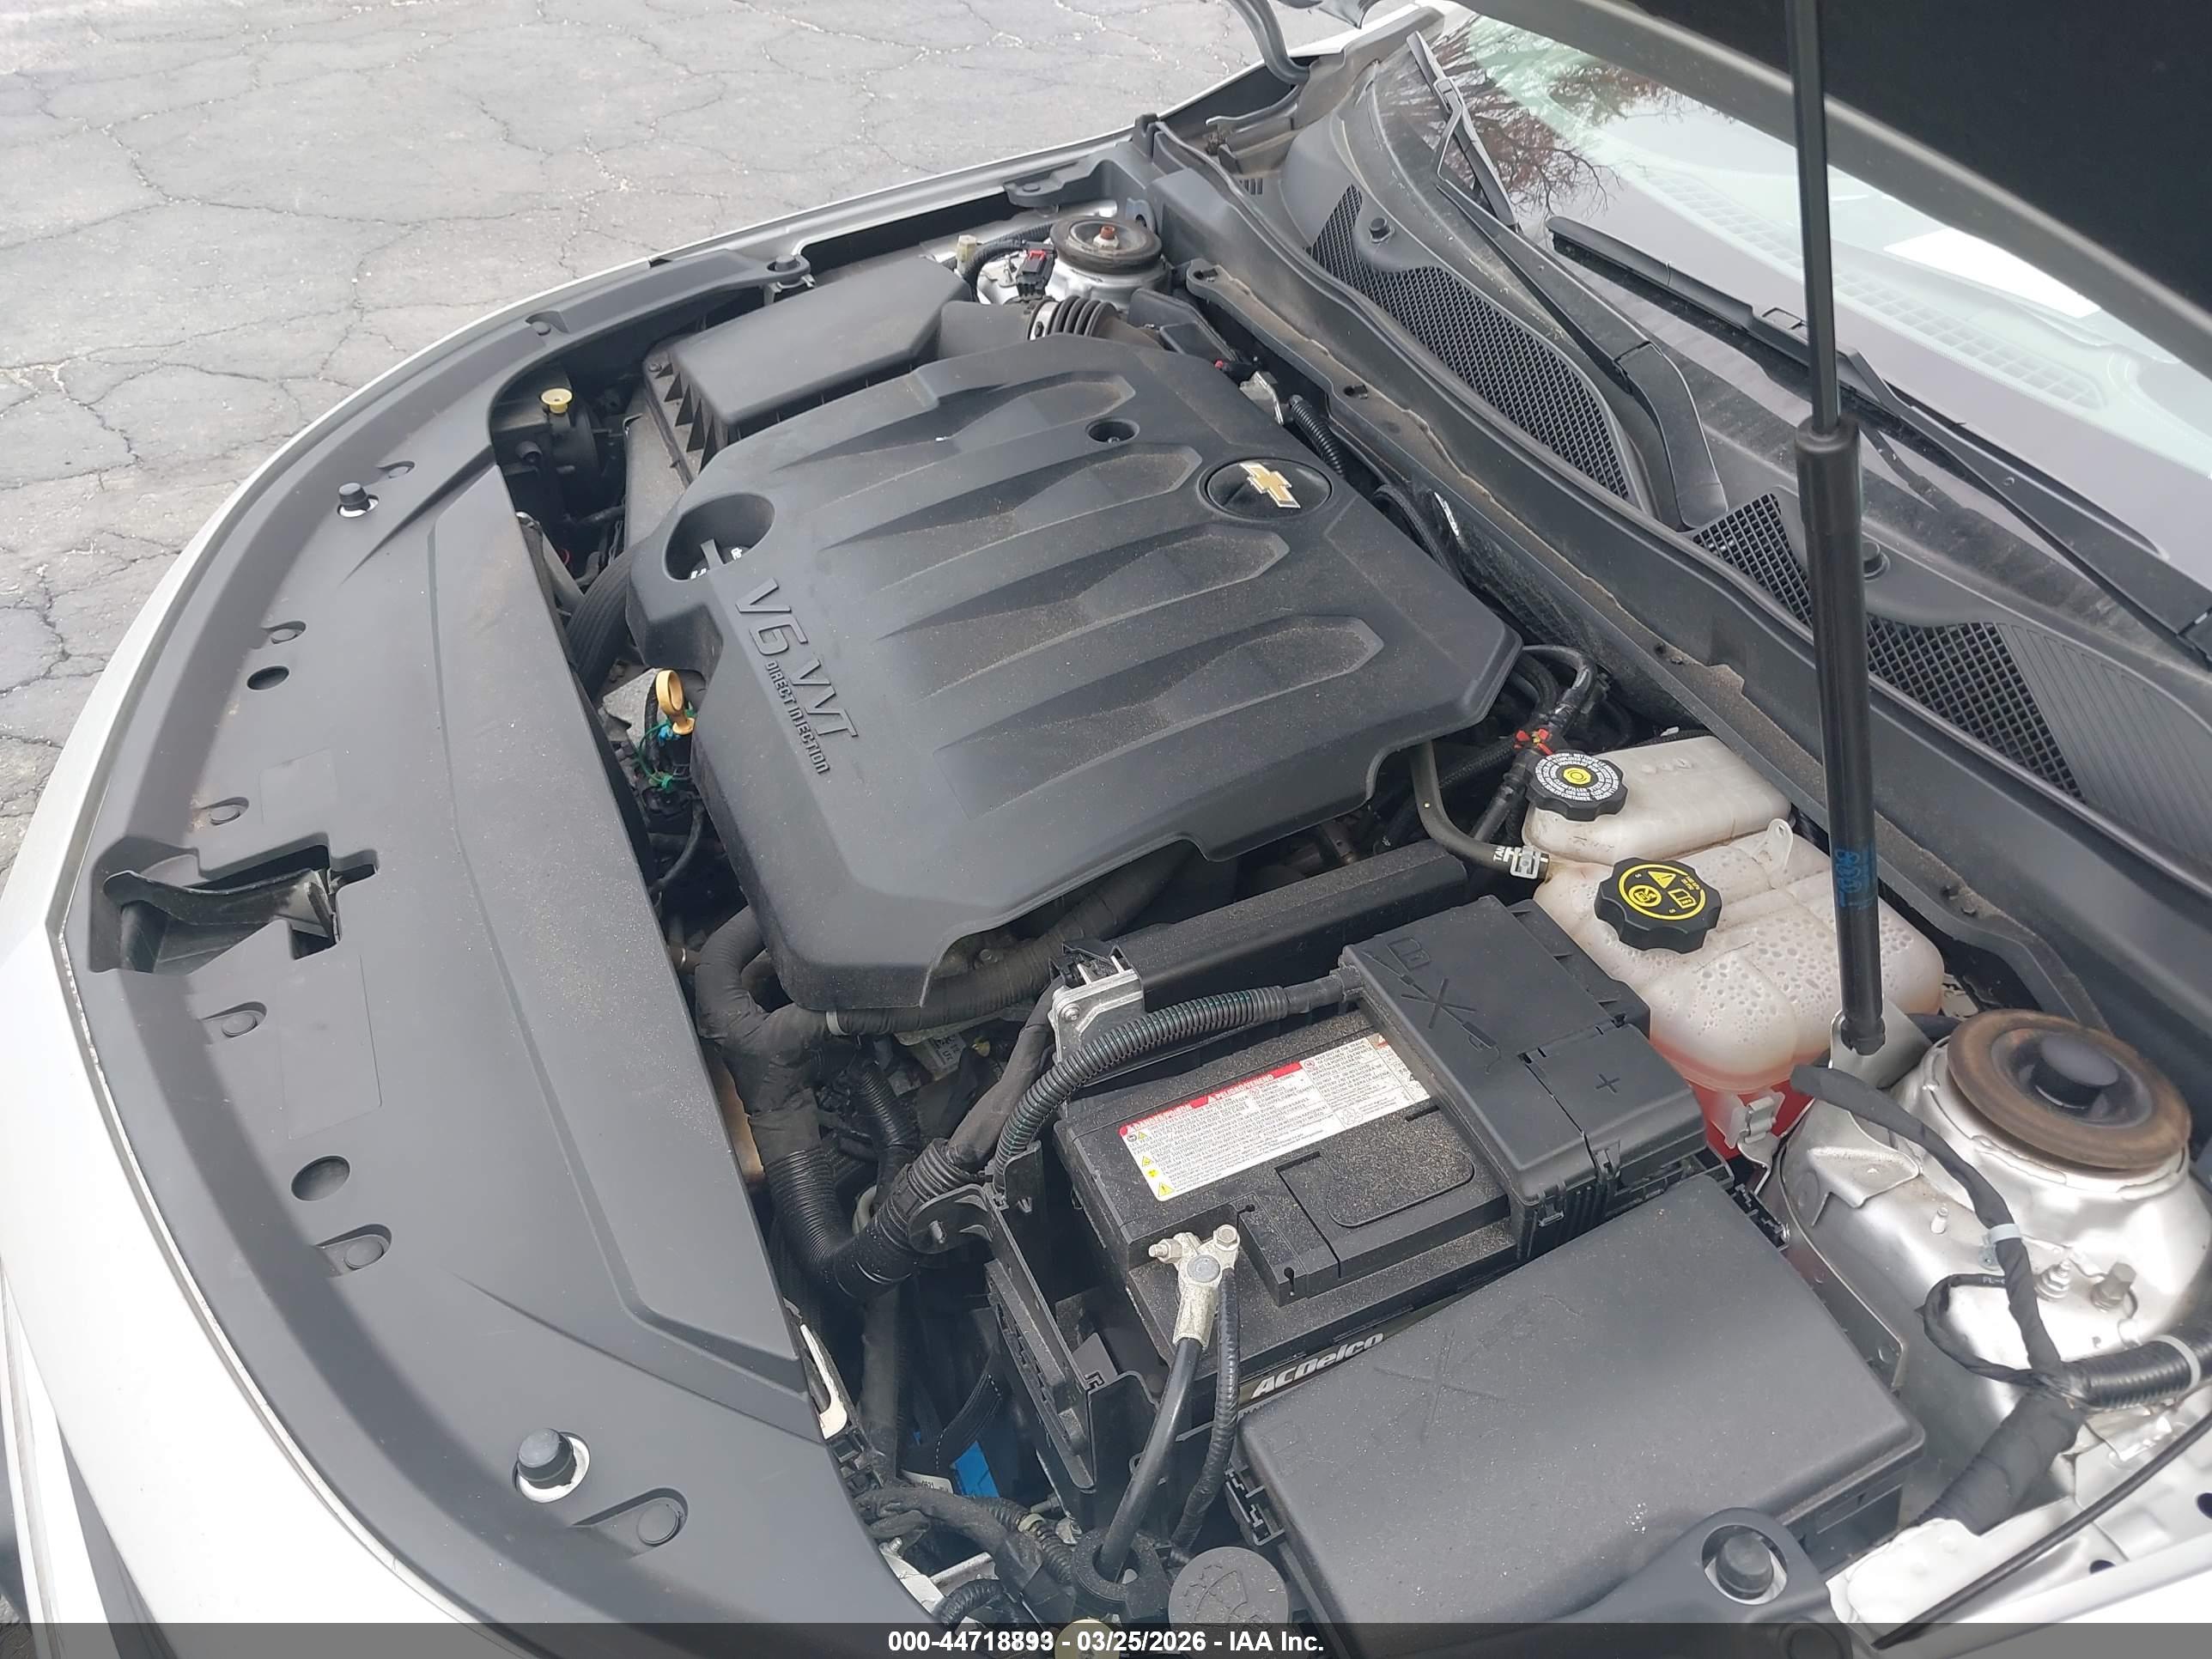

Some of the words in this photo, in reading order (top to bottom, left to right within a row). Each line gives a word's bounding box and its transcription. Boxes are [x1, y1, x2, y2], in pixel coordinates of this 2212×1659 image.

[735, 577, 808, 656] V6
[789, 659, 859, 738] VVT
[765, 660, 797, 706] DIRECT
[787, 706, 830, 775] INJECTION
[1133, 1103, 1193, 1130] DANGER/POISON
[1216, 1073, 1274, 1100] PELIGRO/VENENO
[1250, 1333, 1384, 1400] ACDelco
